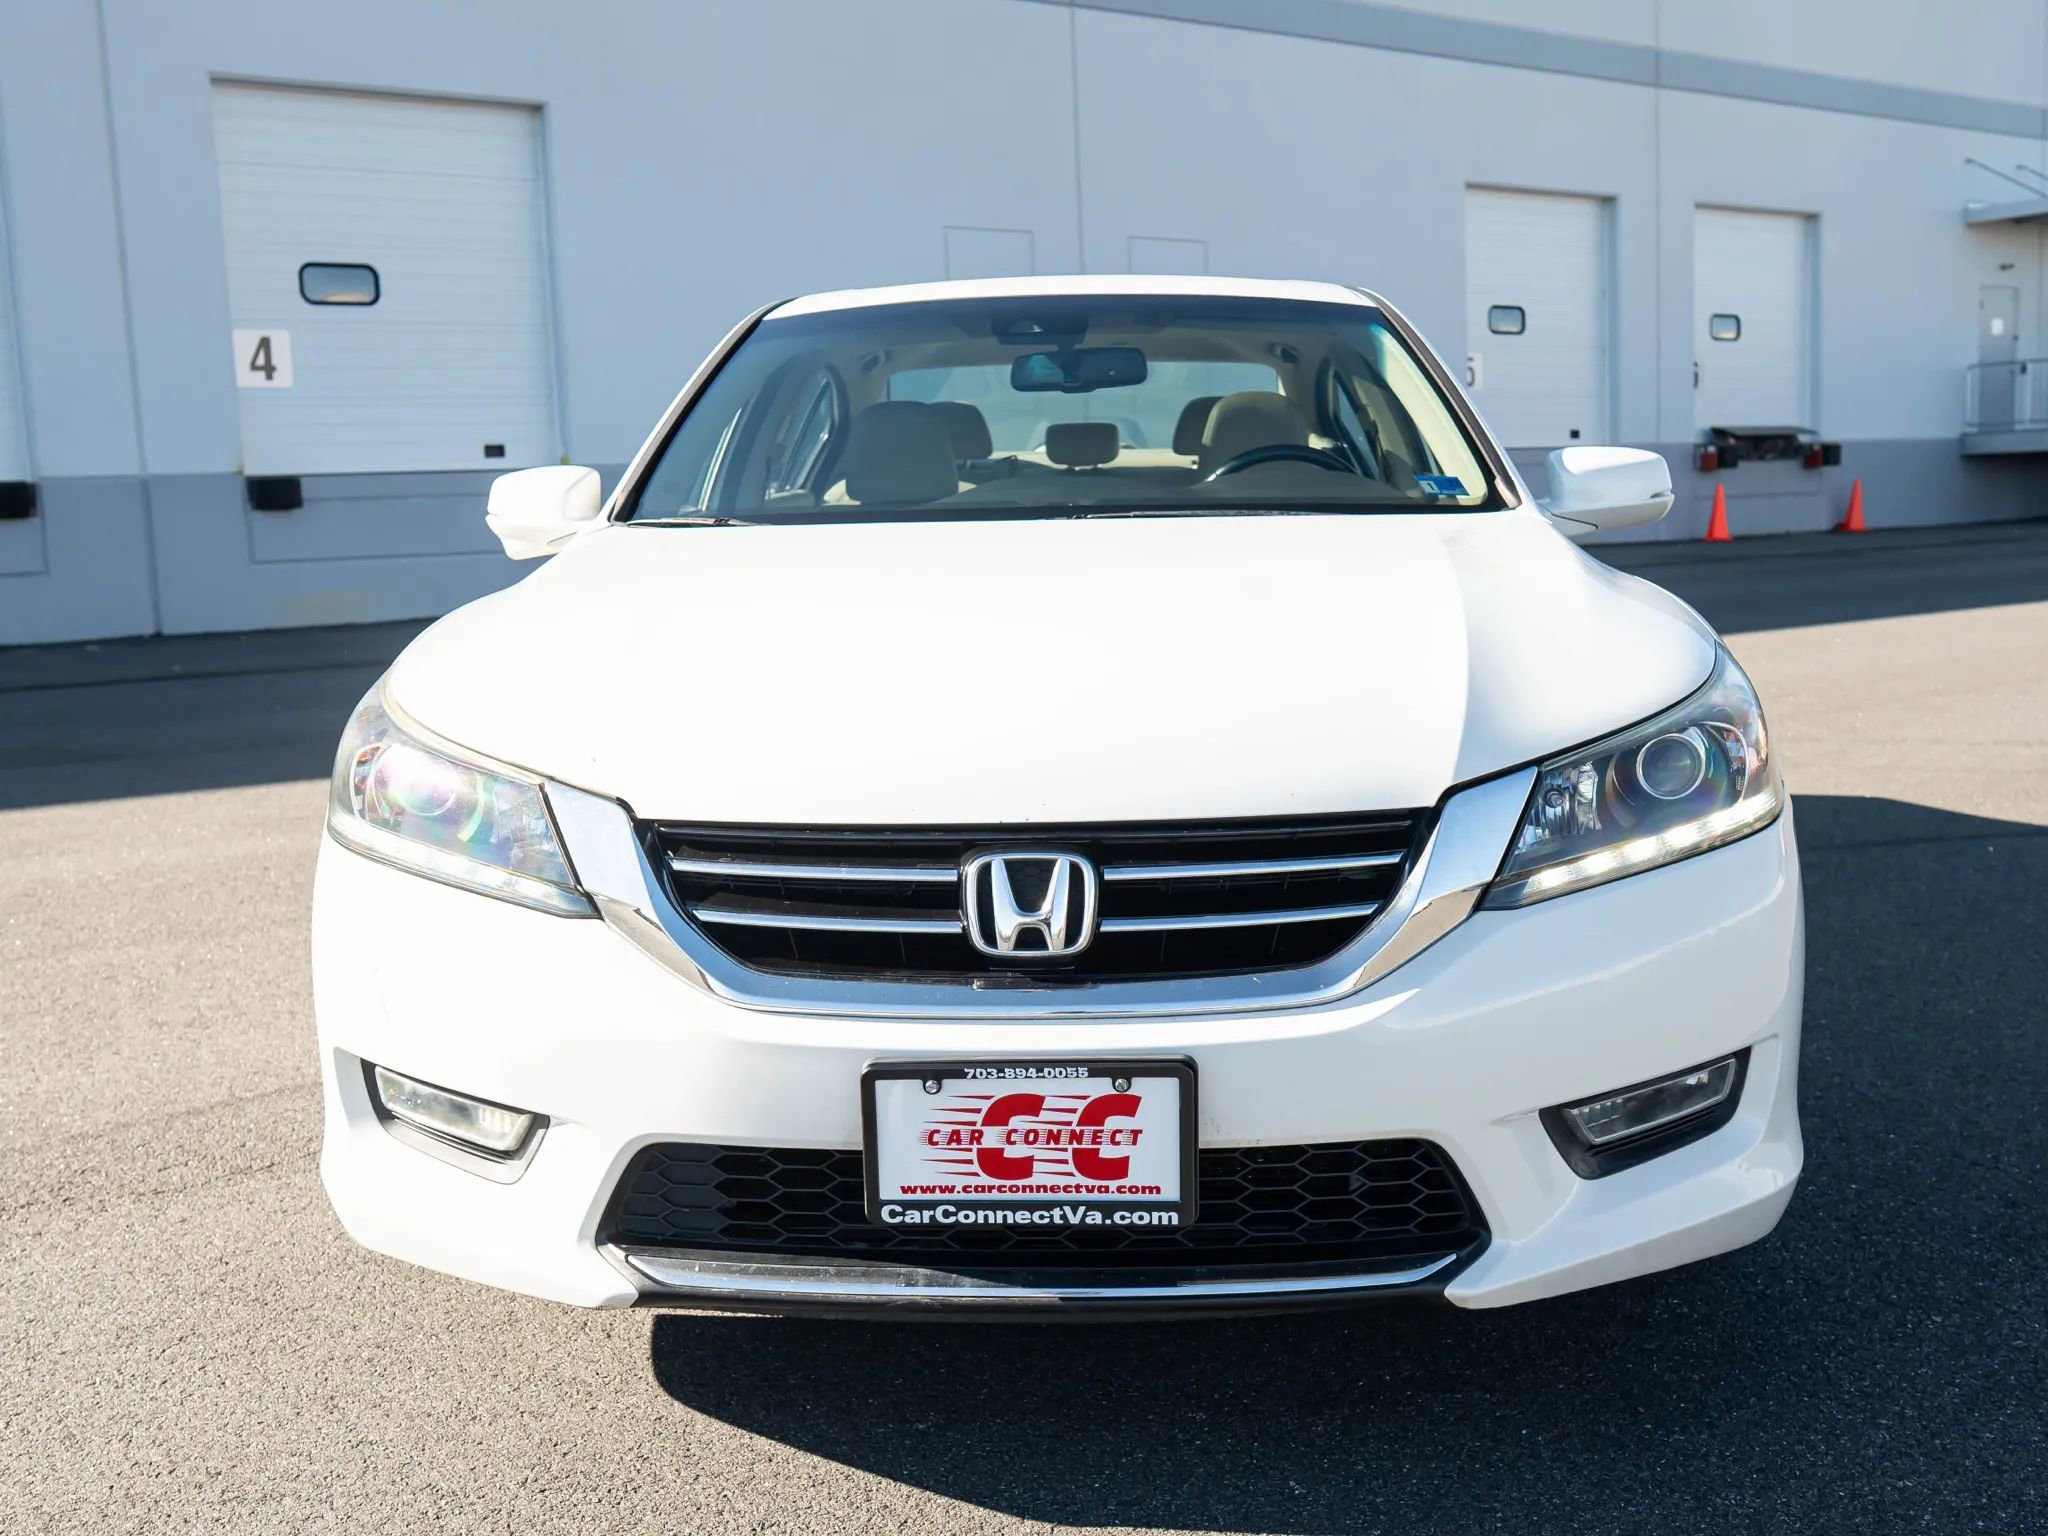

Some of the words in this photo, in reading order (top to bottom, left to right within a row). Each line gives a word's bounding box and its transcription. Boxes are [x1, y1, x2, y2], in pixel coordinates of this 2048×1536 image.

[250, 336, 277, 381] 4
[964, 1067, 1089, 1079] 703-894-0055
[926, 1128, 985, 1147] CAR
[1004, 1128, 1144, 1147] CONNECT
[900, 1182, 1162, 1195] www.carconnectva.com
[880, 1204, 1179, 1226] CarConnectVa.com
